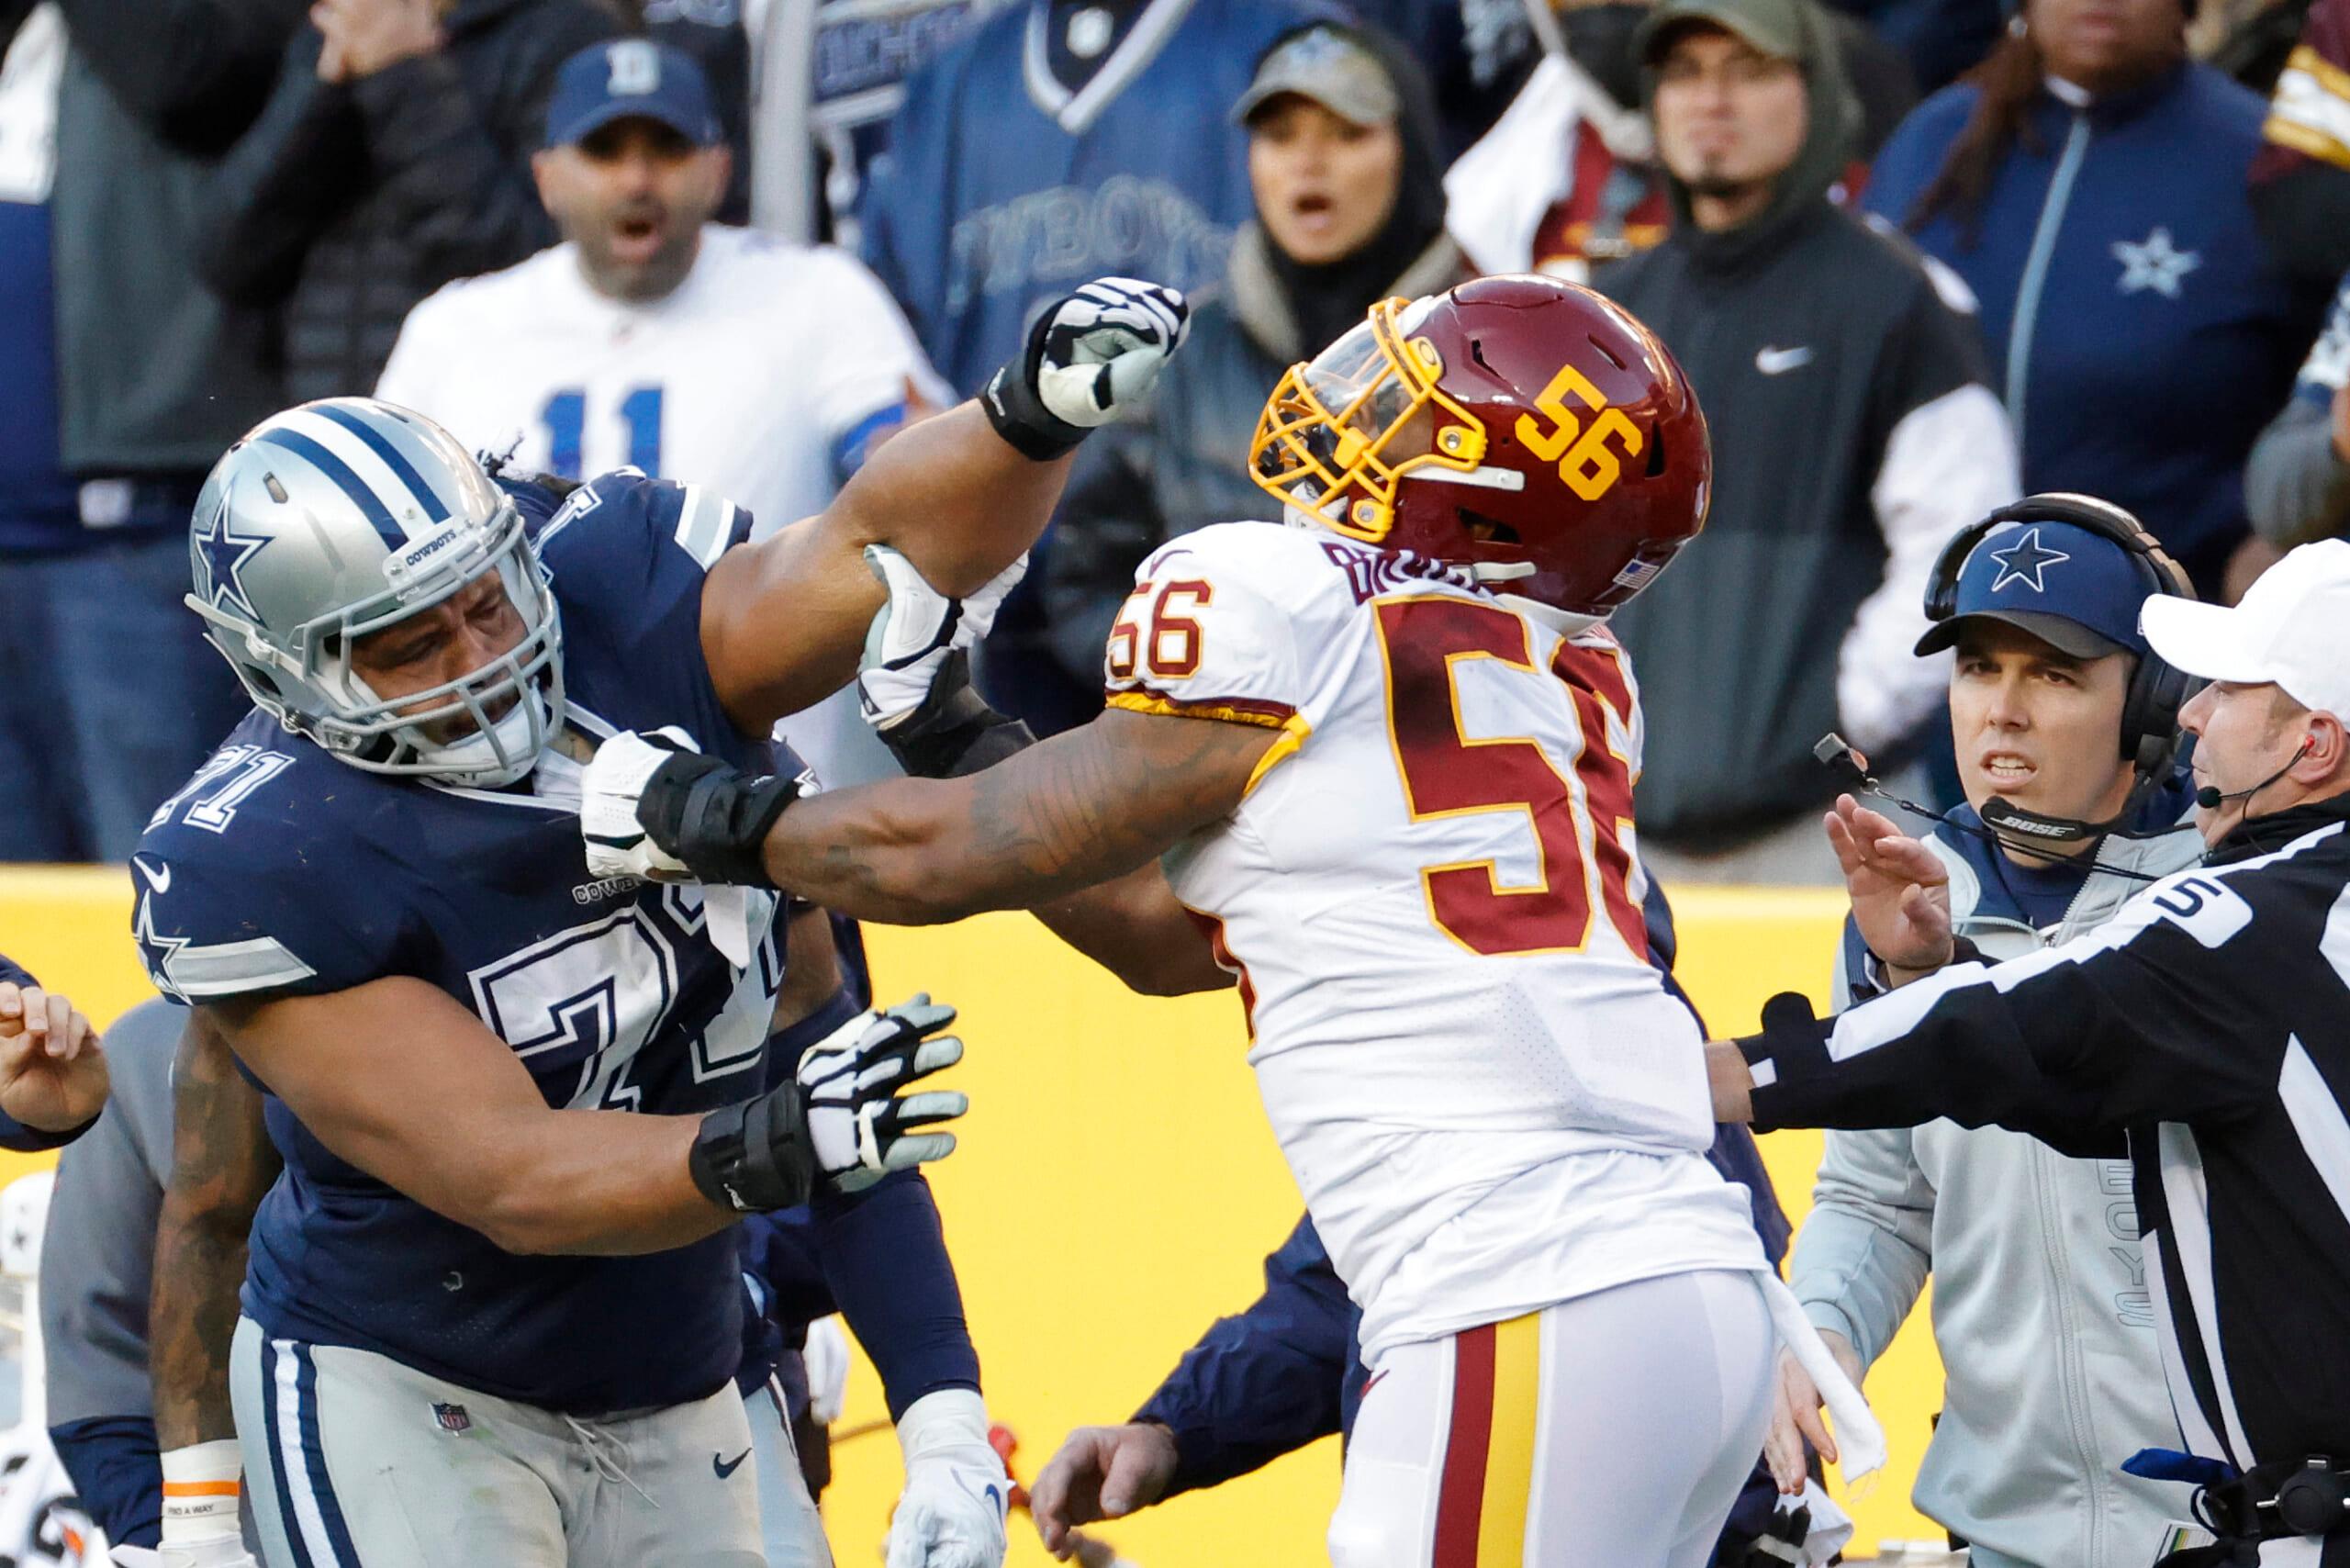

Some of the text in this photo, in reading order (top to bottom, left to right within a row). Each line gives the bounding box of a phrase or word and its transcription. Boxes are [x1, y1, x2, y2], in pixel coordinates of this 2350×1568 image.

[540, 386, 663, 480] 11
[1515, 364, 1643, 501] 56
[406, 529, 456, 566] COWBOYS
[1109, 577, 1215, 681] 56
[1371, 594, 1652, 966] 56
[1989, 815, 2076, 837] BOSE
[2152, 877, 2222, 918] 5
